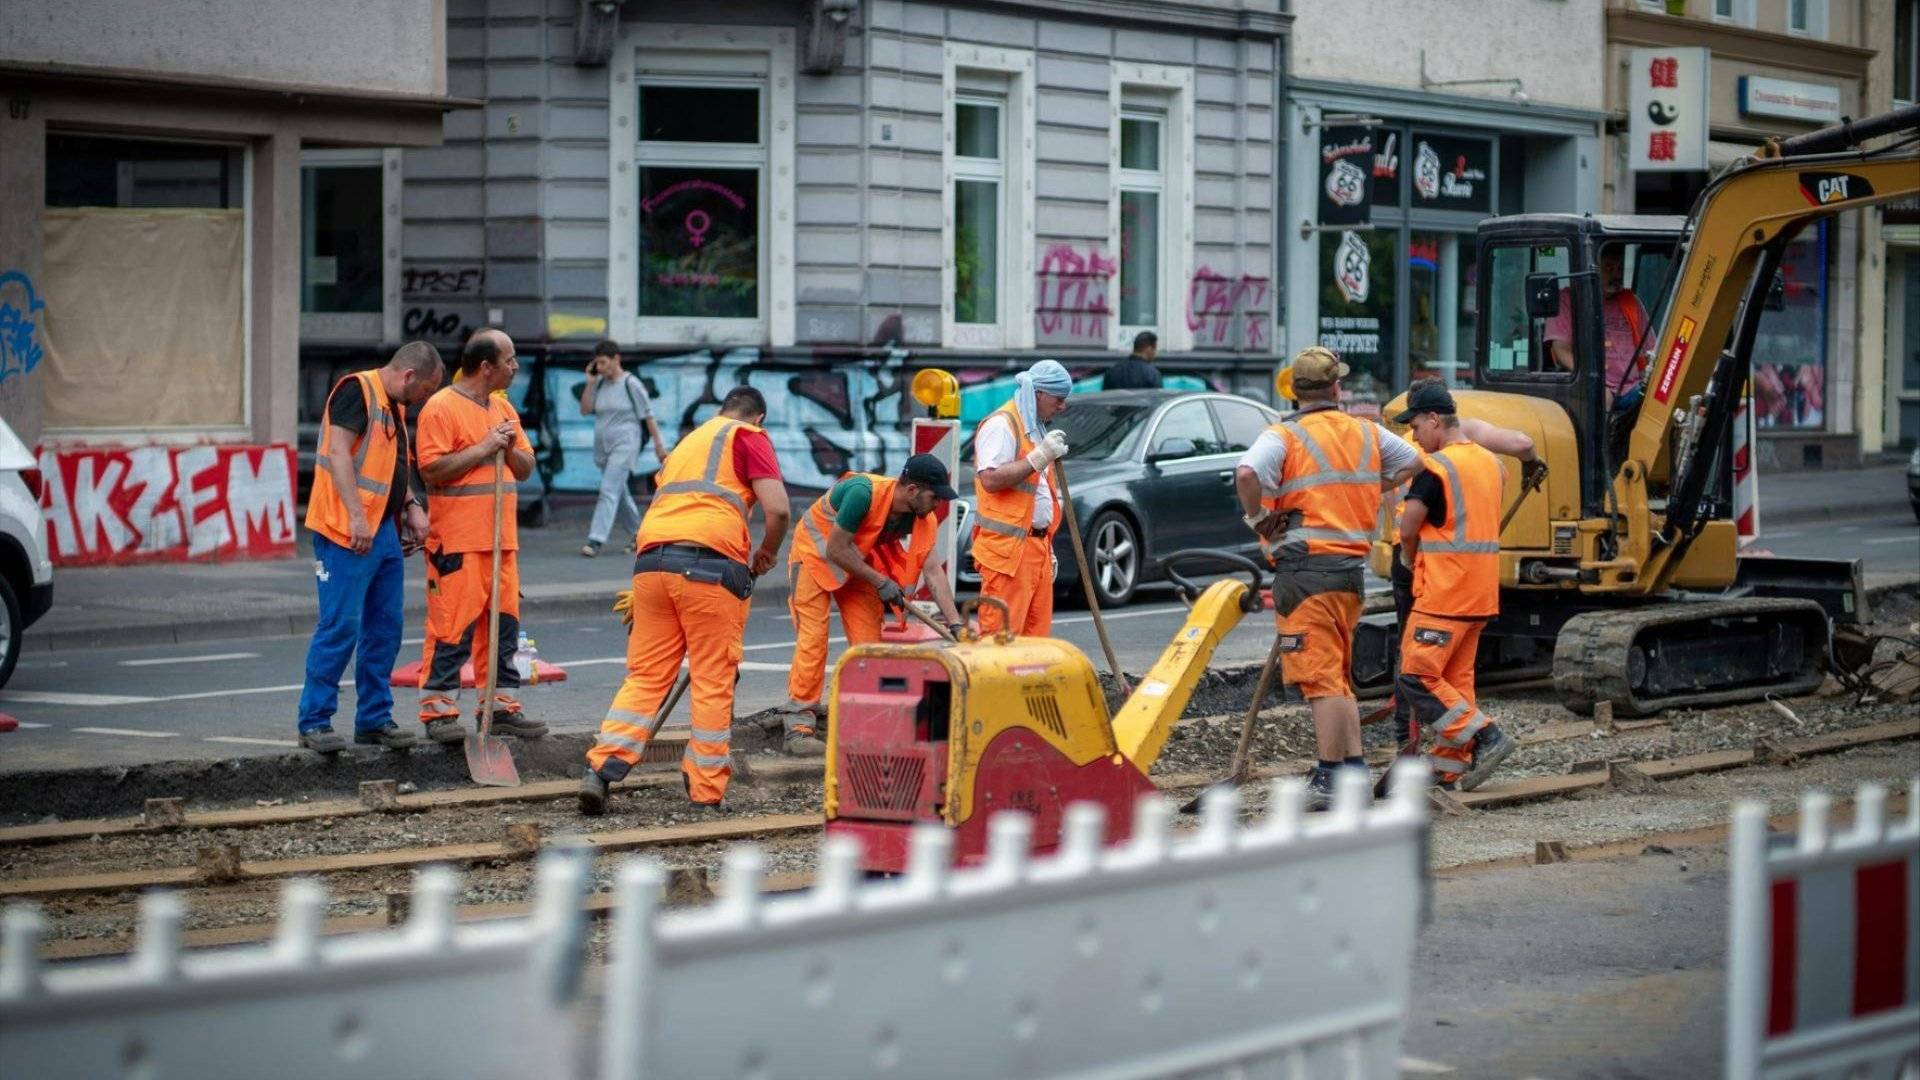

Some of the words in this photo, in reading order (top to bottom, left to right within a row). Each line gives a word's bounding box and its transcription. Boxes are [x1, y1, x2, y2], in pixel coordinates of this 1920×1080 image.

[1819, 175, 1849, 204] CAT
[1320, 330, 1379, 353] GEÖFFNET
[1660, 347, 1682, 394] ZEPPELIN
